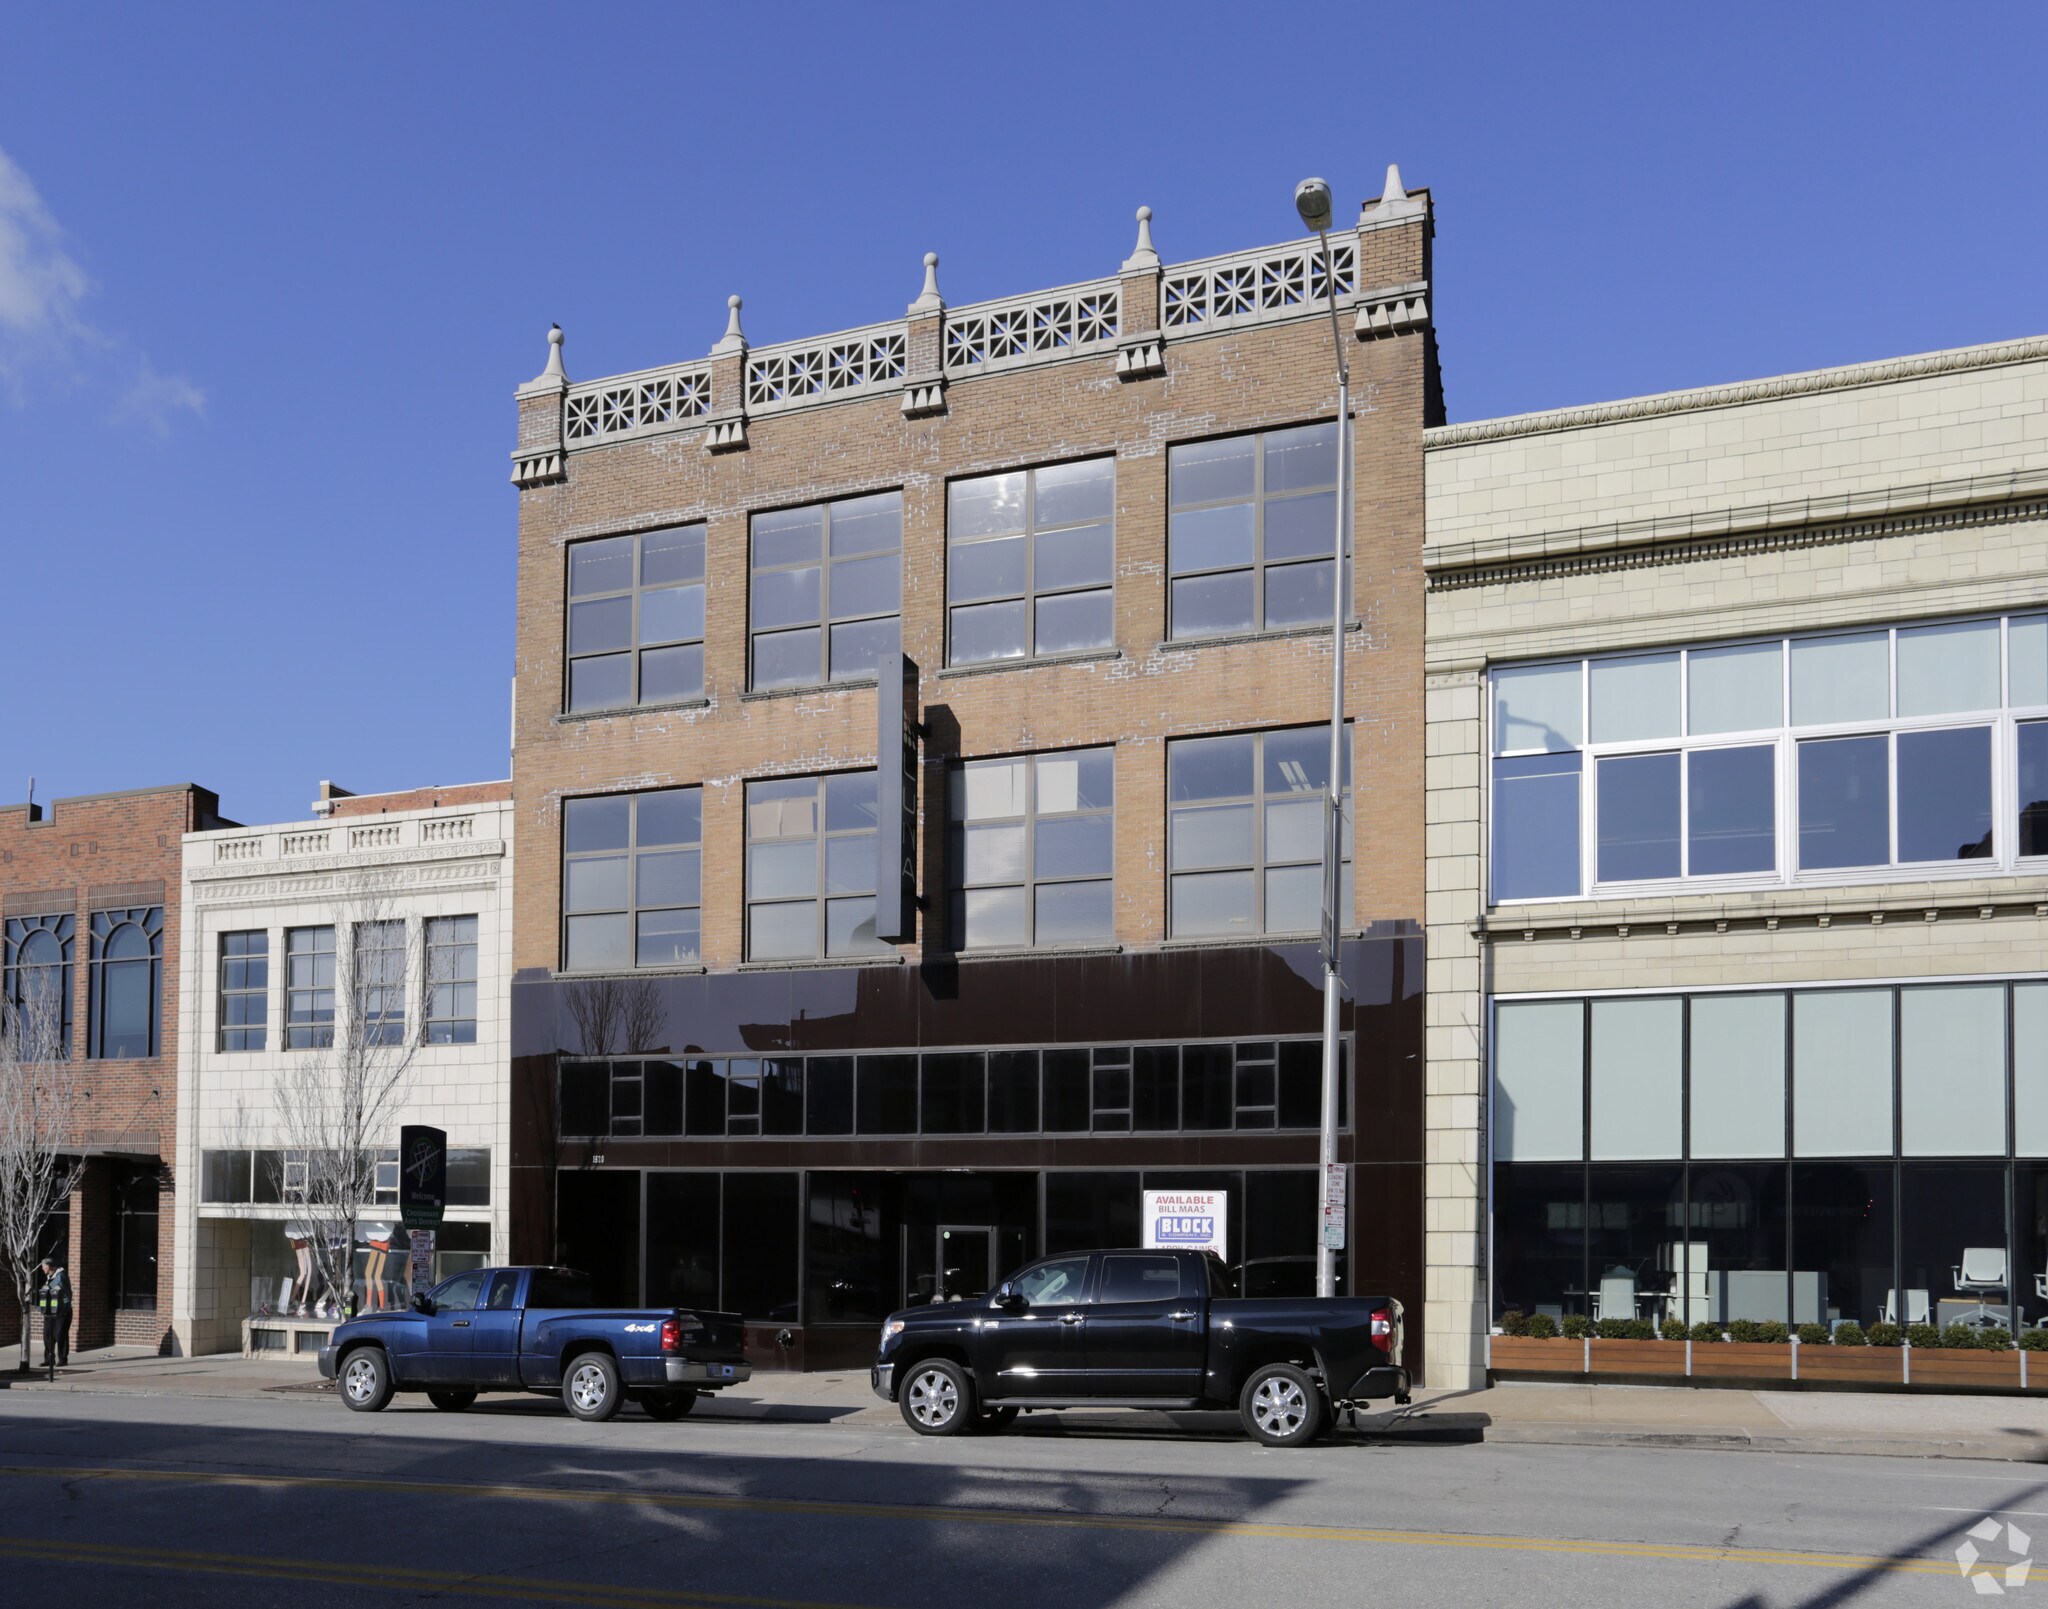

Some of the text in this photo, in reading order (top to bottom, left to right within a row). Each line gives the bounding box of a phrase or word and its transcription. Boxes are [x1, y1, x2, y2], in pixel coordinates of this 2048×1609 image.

[902, 752, 918, 883] LUNA
[411, 1191, 435, 1201] Welcome
[1155, 1196, 1214, 1204] AVAILABLE
[1161, 1218, 1212, 1233] BLOCK
[623, 1323, 656, 1333] 4x4
